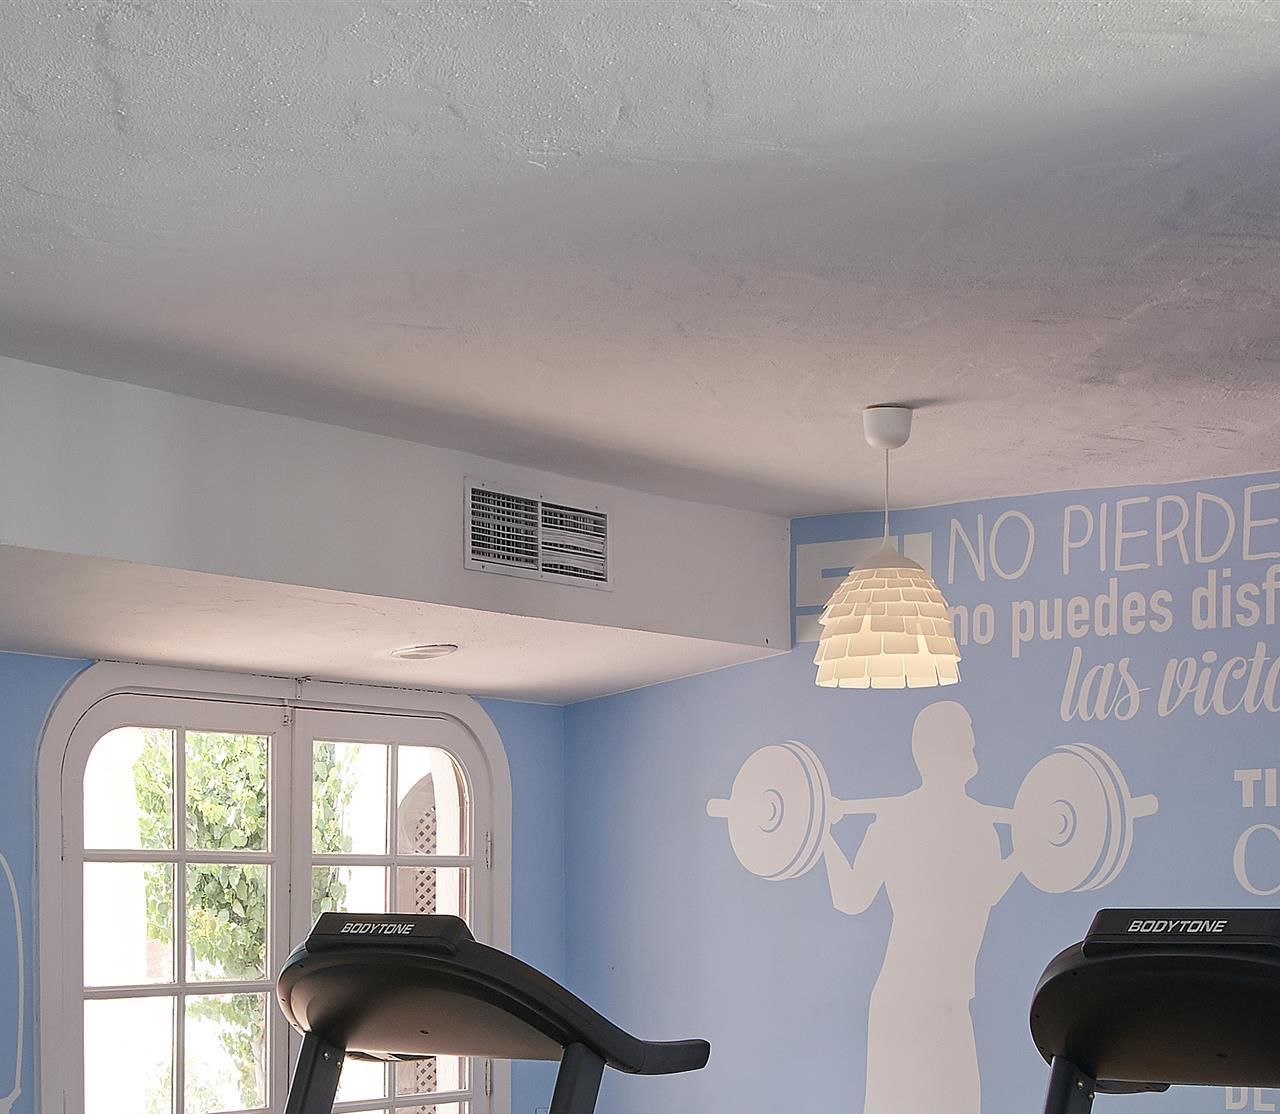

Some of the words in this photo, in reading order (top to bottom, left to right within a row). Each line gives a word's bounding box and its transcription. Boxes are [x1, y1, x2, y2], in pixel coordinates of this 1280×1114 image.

[948, 510, 1035, 584] NO
[948, 603, 995, 645] no
[1011, 577, 1173, 658] puedes
[1060, 646, 1152, 723] las
[341, 922, 415, 935] BODYTONE
[1127, 919, 1228, 933] BODYTONE
